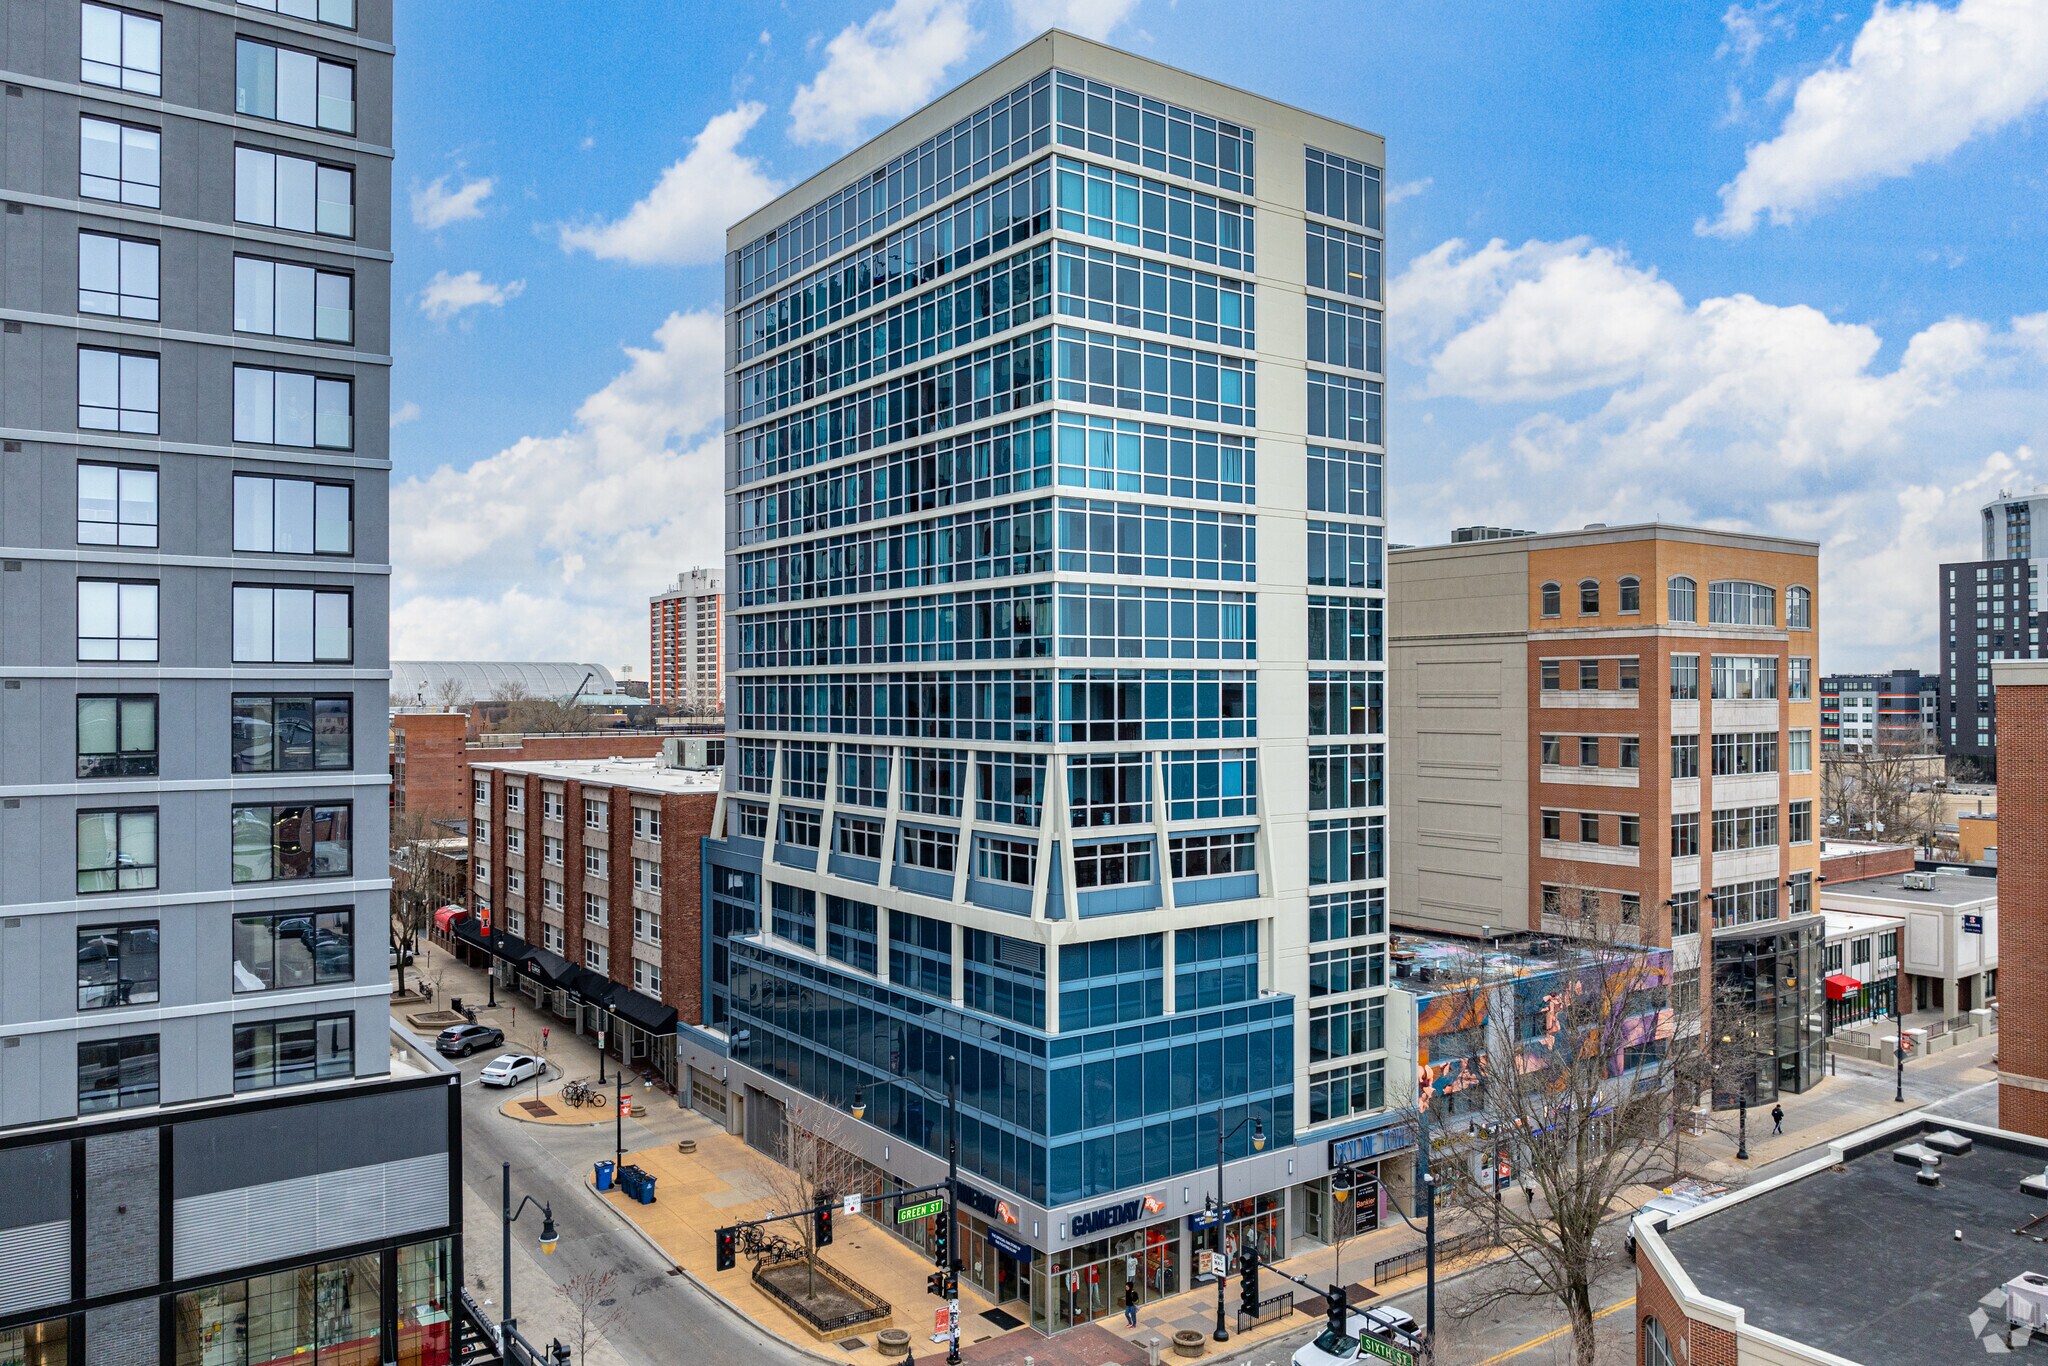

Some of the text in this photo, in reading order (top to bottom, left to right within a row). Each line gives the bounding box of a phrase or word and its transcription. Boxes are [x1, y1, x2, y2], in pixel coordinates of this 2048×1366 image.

[1335, 1133, 1377, 1165] SKYLINE
[901, 1202, 940, 1220] GREEN ST
[1072, 1199, 1140, 1237] GAMEDAY
[1365, 1339, 1407, 1366] SIXTH ST
